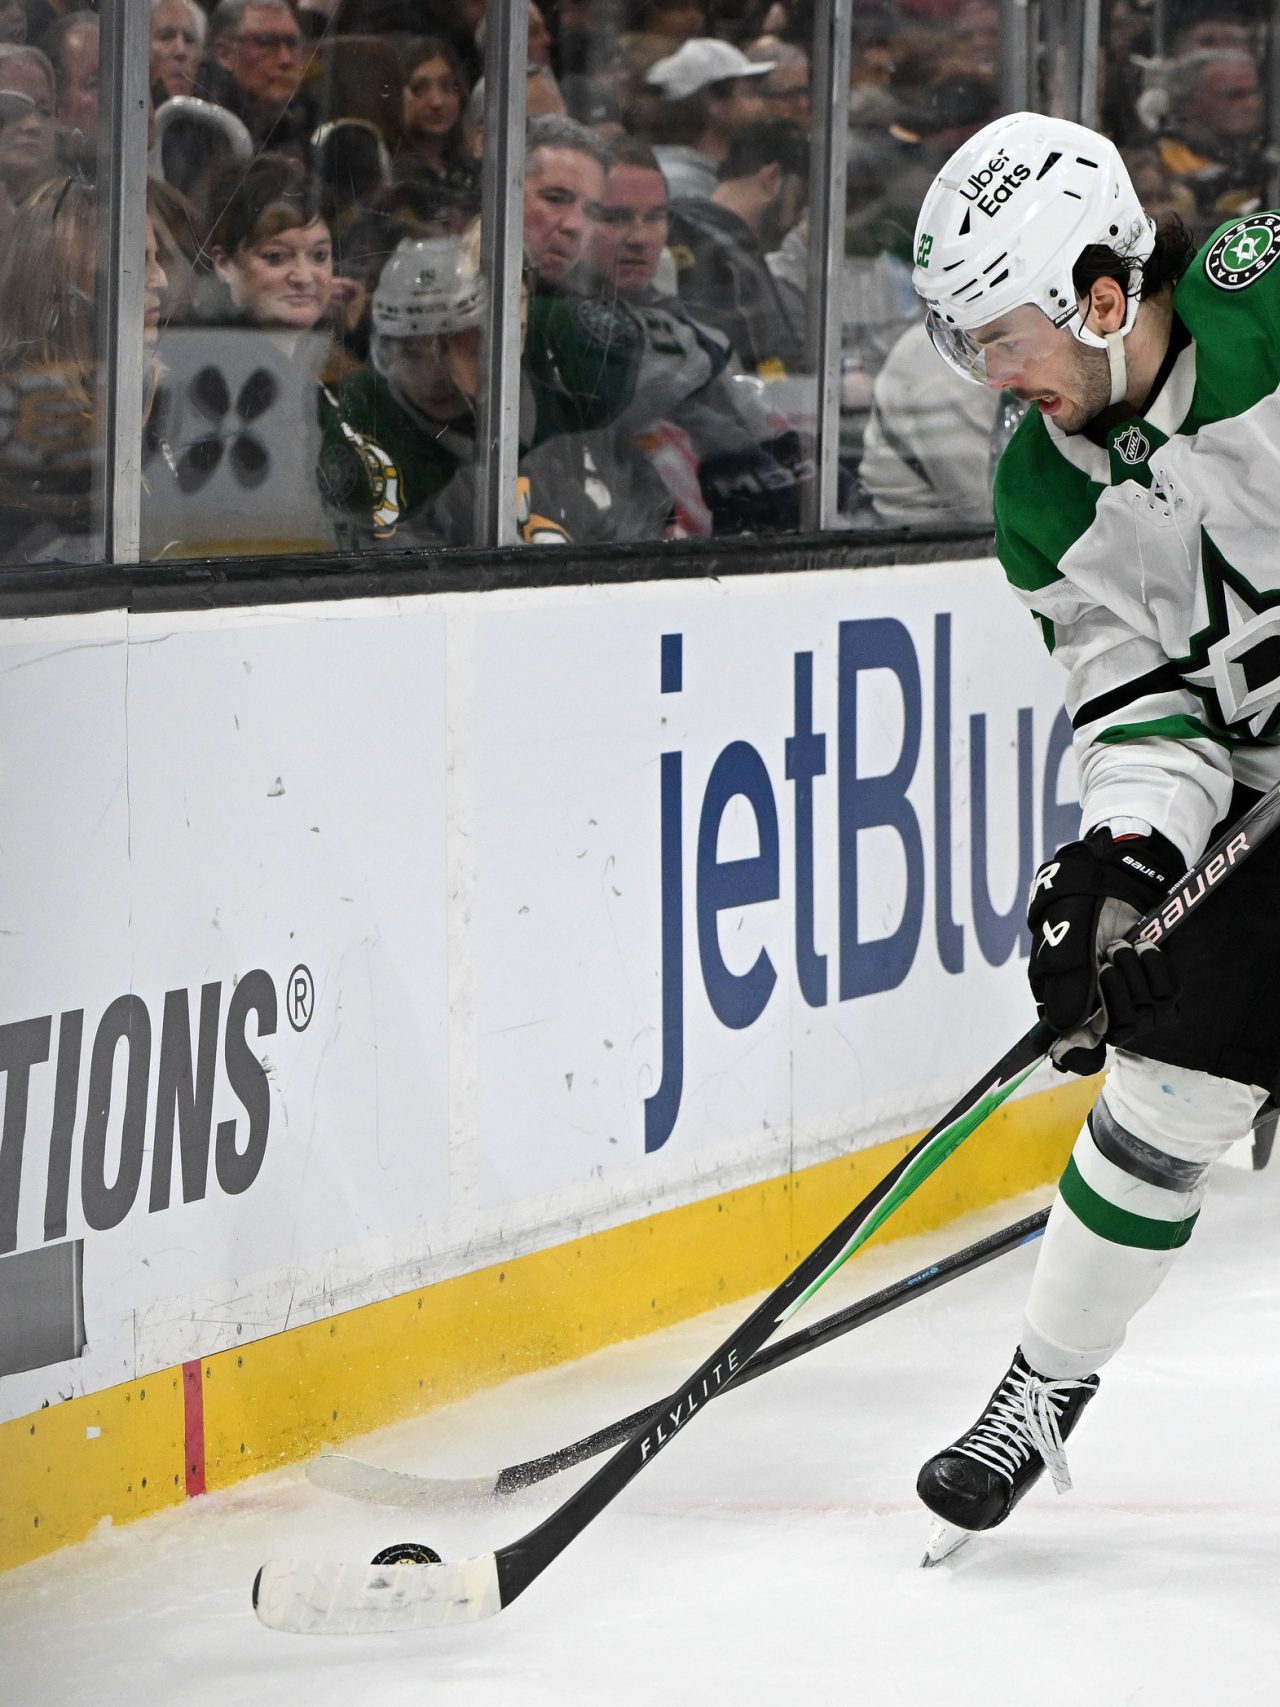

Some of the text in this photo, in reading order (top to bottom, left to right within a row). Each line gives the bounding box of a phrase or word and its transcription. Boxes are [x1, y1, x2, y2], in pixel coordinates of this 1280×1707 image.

[959, 148, 1010, 201] Uber
[977, 164, 1031, 218] Eats
[916, 233, 934, 268] 22
[1211, 223, 1247, 283] DALLAS
[1127, 435, 1140, 460] NHL
[1121, 855, 1166, 883] BAUER
[1140, 831, 1251, 945] BAUER
[640, 1348, 740, 1461] FLYLITE
